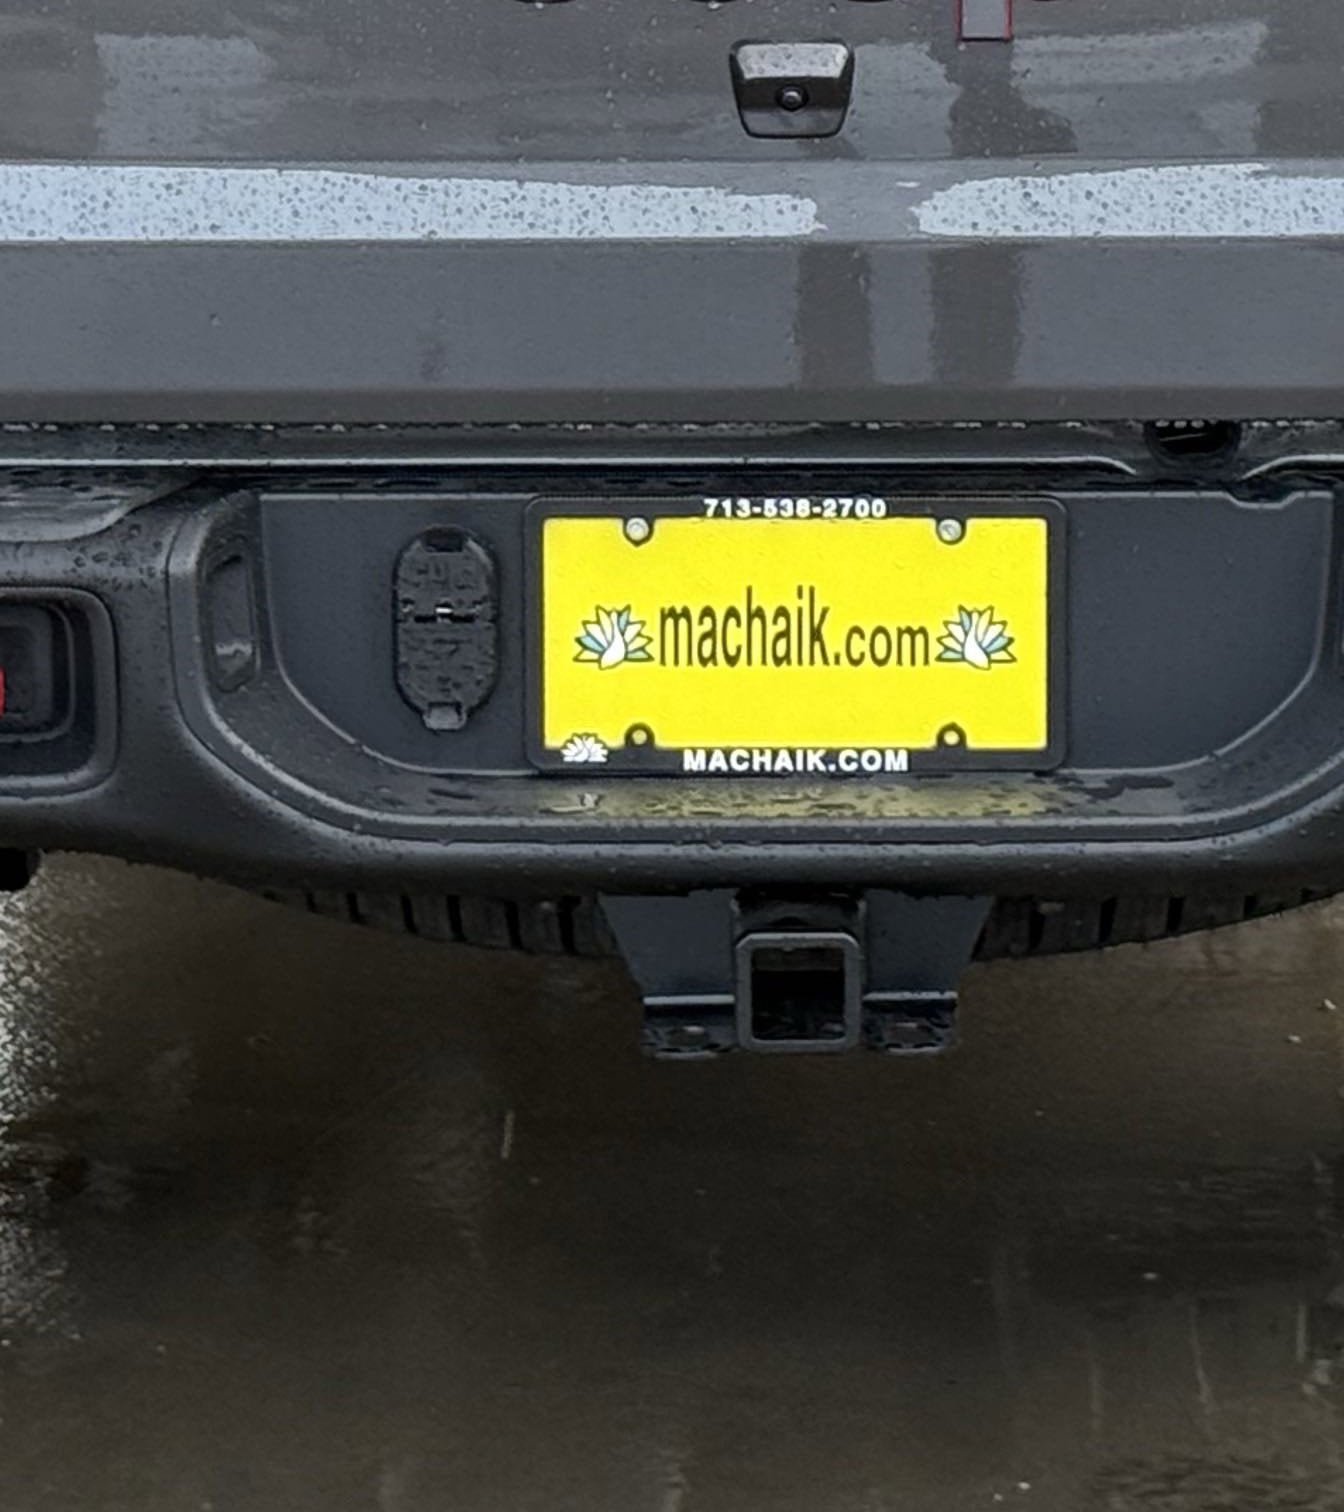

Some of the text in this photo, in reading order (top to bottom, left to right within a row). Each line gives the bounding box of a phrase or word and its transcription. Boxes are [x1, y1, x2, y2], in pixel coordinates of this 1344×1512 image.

[703, 499, 887, 518] 713-538-2700
[659, 585, 930, 667] machaik.com
[682, 749, 909, 772] MACHAIK.COM
